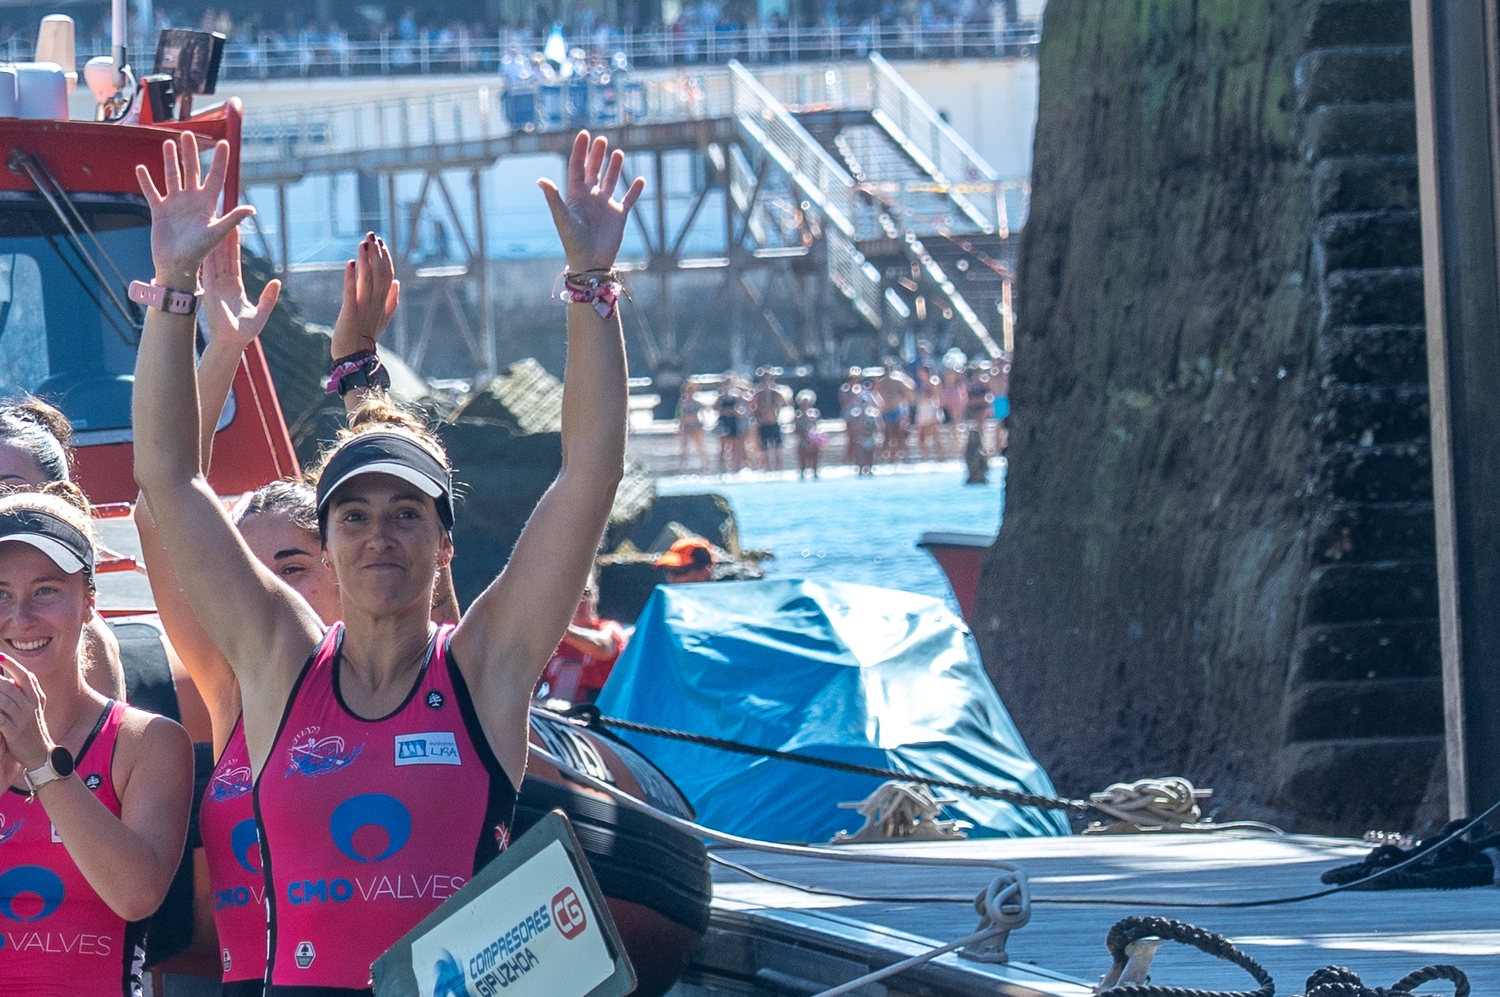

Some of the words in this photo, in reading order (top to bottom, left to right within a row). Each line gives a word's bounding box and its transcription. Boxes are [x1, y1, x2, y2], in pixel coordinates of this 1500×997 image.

[287, 877, 354, 906] CMO
[355, 873, 470, 902] VALVES
[8, 931, 113, 957] VALVES
[469, 904, 552, 981] COMPRESORES
